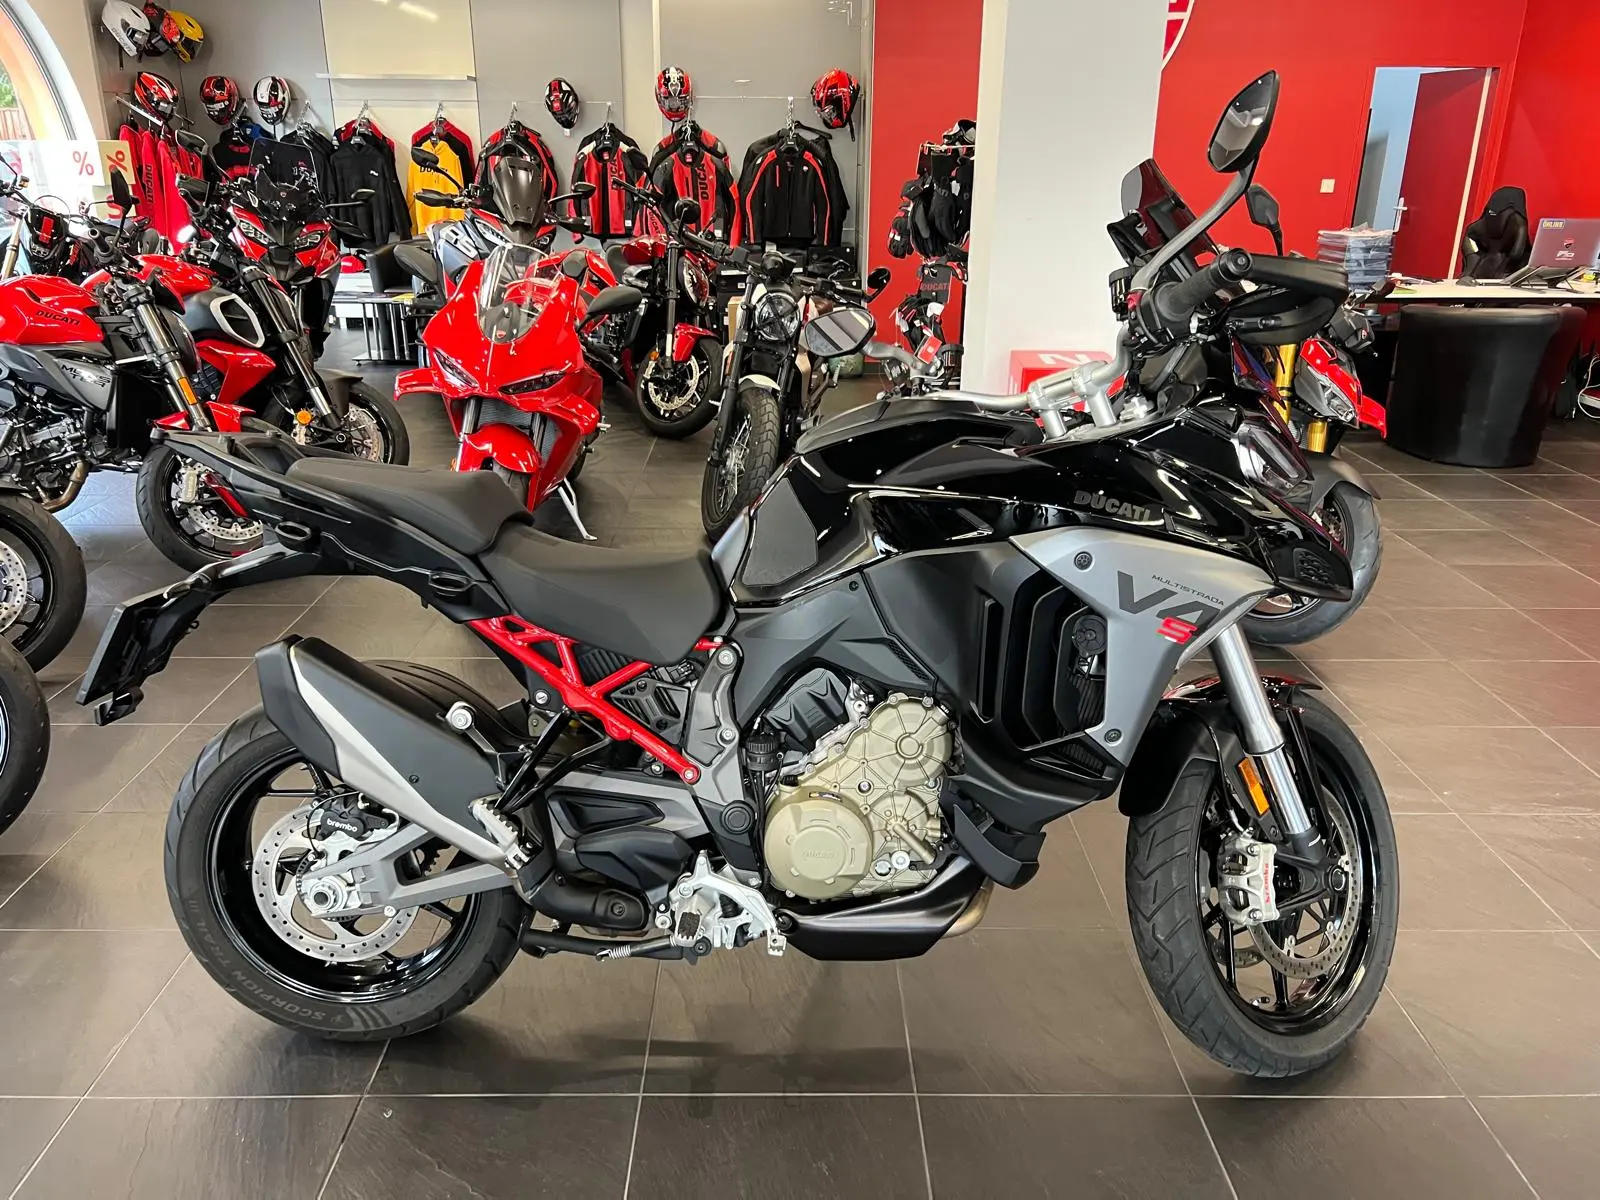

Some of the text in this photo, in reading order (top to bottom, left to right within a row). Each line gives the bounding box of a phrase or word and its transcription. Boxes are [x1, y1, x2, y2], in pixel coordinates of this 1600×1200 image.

[145, 164, 156, 205] DUCATI
[36, 310, 80, 326] DUCATI
[1073, 490, 1151, 521] DUCATI
[1151, 574, 1225, 606] MULTISTRADA
[1155, 616, 1198, 645] S
[326, 817, 358, 833] brembo
[196, 920, 232, 968] TRAIL
[231, 969, 328, 1022] SCORPION
